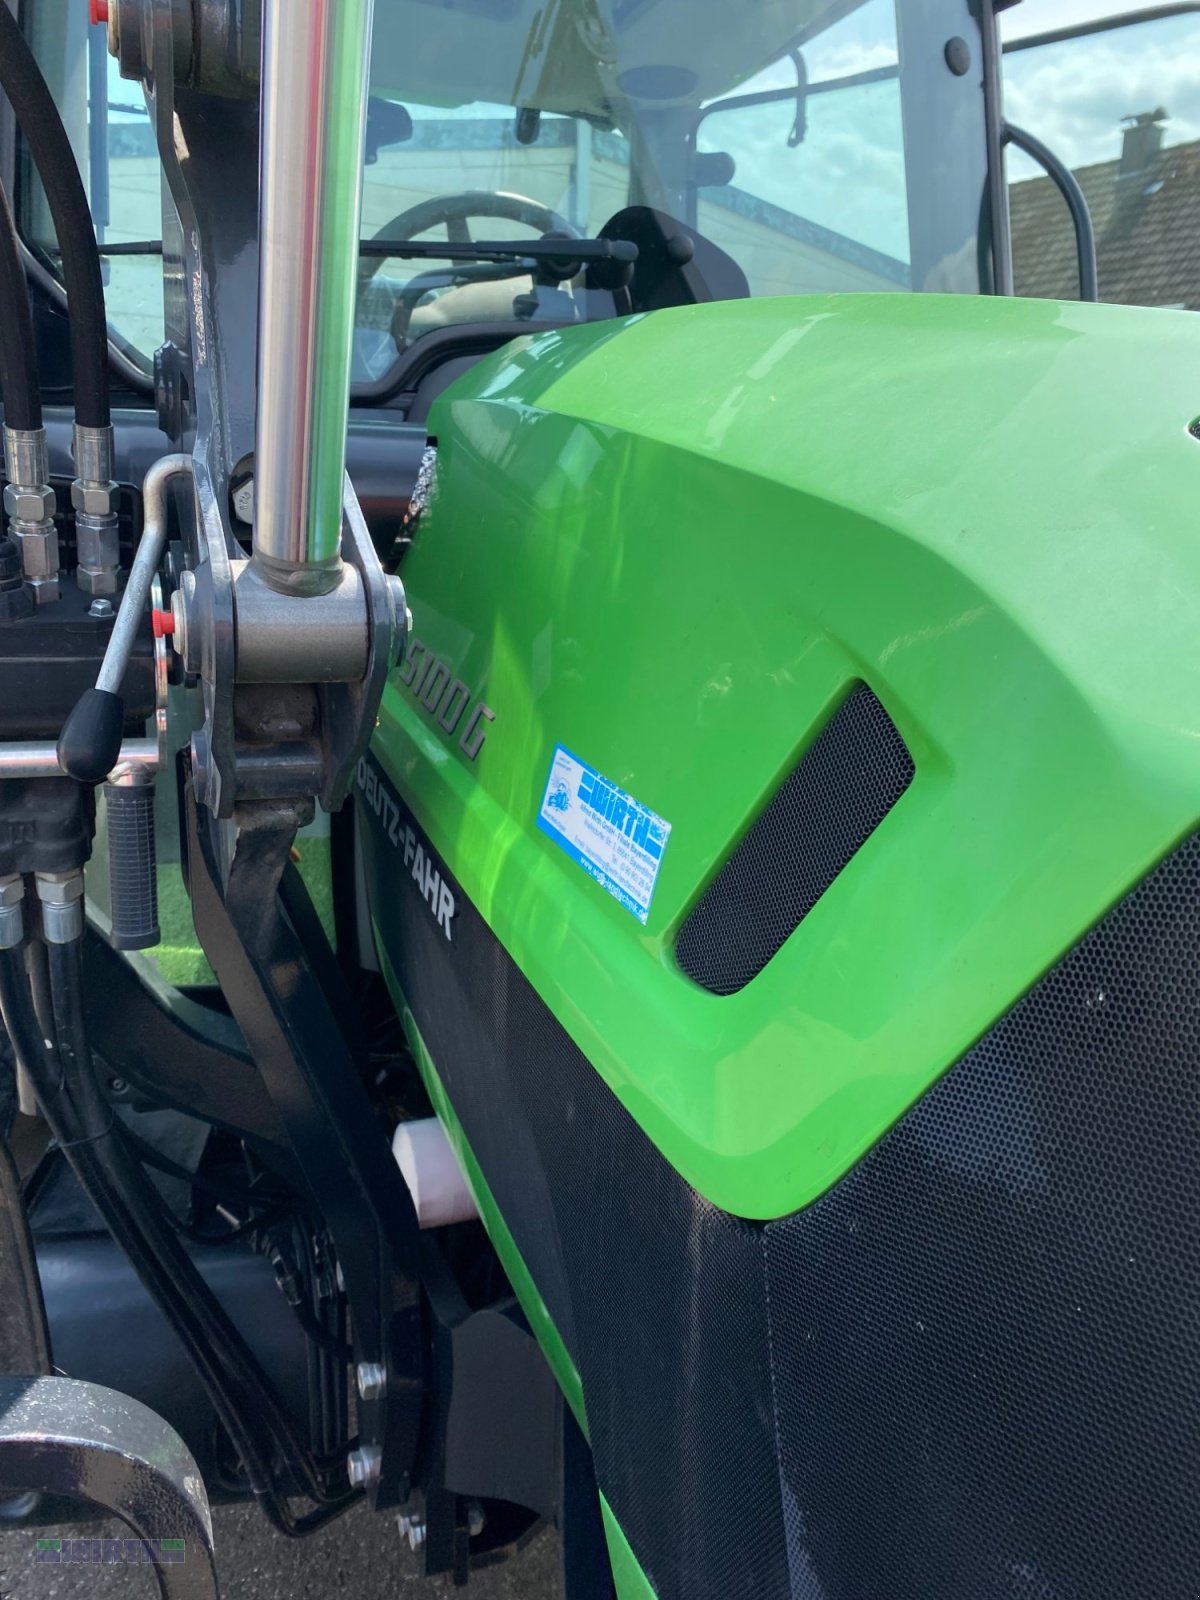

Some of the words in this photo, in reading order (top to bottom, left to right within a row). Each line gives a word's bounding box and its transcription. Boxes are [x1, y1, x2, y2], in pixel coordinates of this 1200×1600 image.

[399, 638, 471, 736] 5100
[458, 701, 496, 761] G
[357, 754, 455, 942] DEUTZ-FAHR
[588, 778, 652, 849] WIRTH
[601, 819, 616, 837] GmbH
